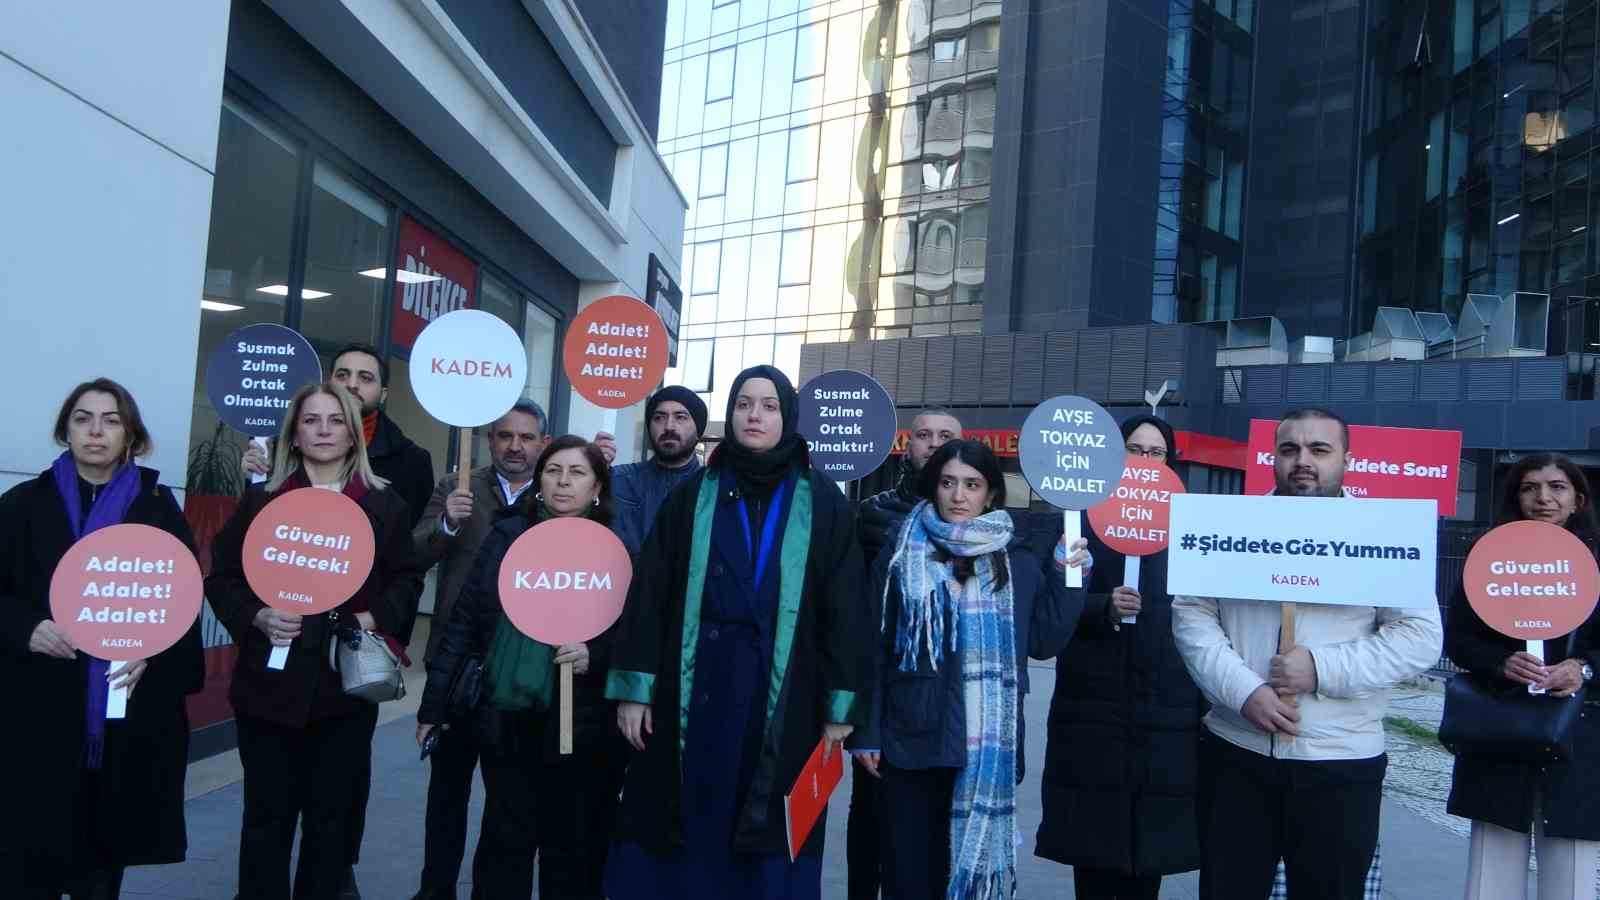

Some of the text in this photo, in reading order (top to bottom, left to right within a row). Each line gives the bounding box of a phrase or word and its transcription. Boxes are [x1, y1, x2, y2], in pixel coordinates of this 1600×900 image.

[587, 321, 649, 338] Adalet!
[237, 342, 296, 356] Susmak
[585, 342, 648, 358] Adalet!
[242, 360, 288, 373] Zulme
[431, 357, 512, 379] KADEM
[581, 362, 644, 379] Adalet!
[241, 377, 286, 391] Ortak
[597, 388, 626, 398] KADEM
[814, 388, 870, 400] Susmak
[223, 394, 292, 409] Olmaktır
[819, 406, 864, 417] Zulme
[1053, 409, 1094, 427] AYŞE
[244, 417, 276, 426] KADEM
[820, 423, 862, 435] Ortak
[1040, 429, 1106, 448] TOKYAZ
[824, 463, 855, 471] KADEM
[1056, 450, 1090, 471] İÇİN
[1121, 467, 1161, 484] AYŞE
[1403, 462, 1448, 479] Son!
[1040, 476, 1106, 493] ADALET
[1110, 487, 1169, 503] OKYAZ
[1120, 503, 1153, 522] İÇİN
[274, 524, 352, 551] Güvenli
[1104, 525, 1167, 542] ADALET
[85, 556, 174, 575] Adalet!
[263, 546, 351, 575] Gelecek!
[1490, 560, 1569, 575] Güvenli
[514, 570, 613, 590] KADEM
[1271, 573, 1320, 587] KADEM
[82, 581, 172, 599] Adalet!
[278, 590, 313, 604] KADEM
[1486, 582, 1577, 597] Gelecek!
[77, 606, 167, 624] Adalet!
[1514, 620, 1552, 629] KADEM
[101, 638, 143, 648] KADEM
